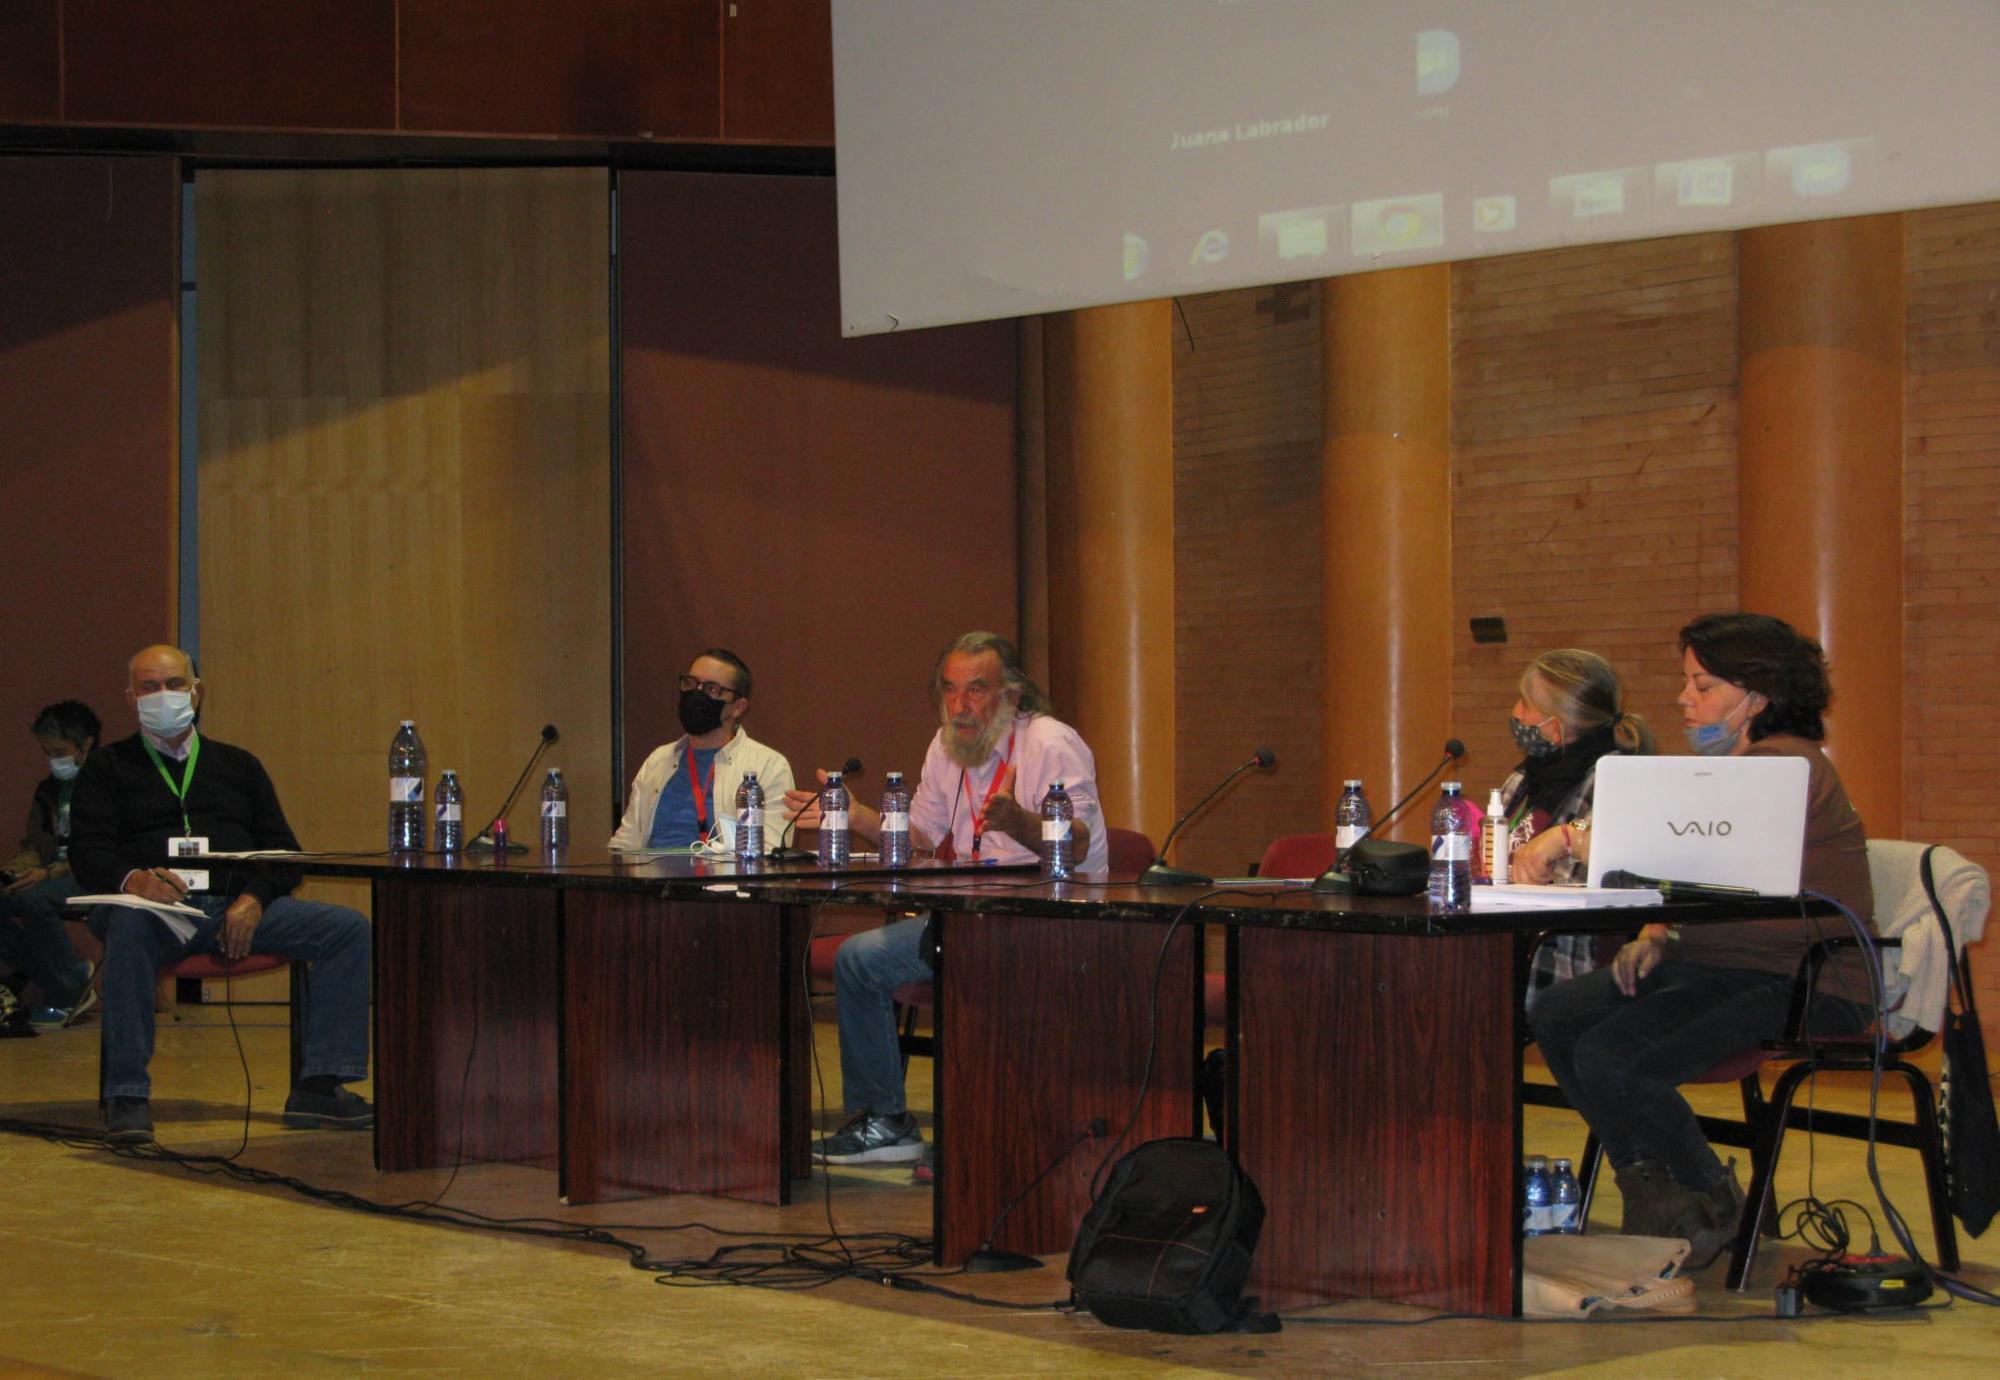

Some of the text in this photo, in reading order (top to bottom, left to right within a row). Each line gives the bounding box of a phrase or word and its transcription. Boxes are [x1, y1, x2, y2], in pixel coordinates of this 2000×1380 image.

[1169, 114, 1330, 151] Juana Labrador
[1666, 820, 1733, 837] VAIO
